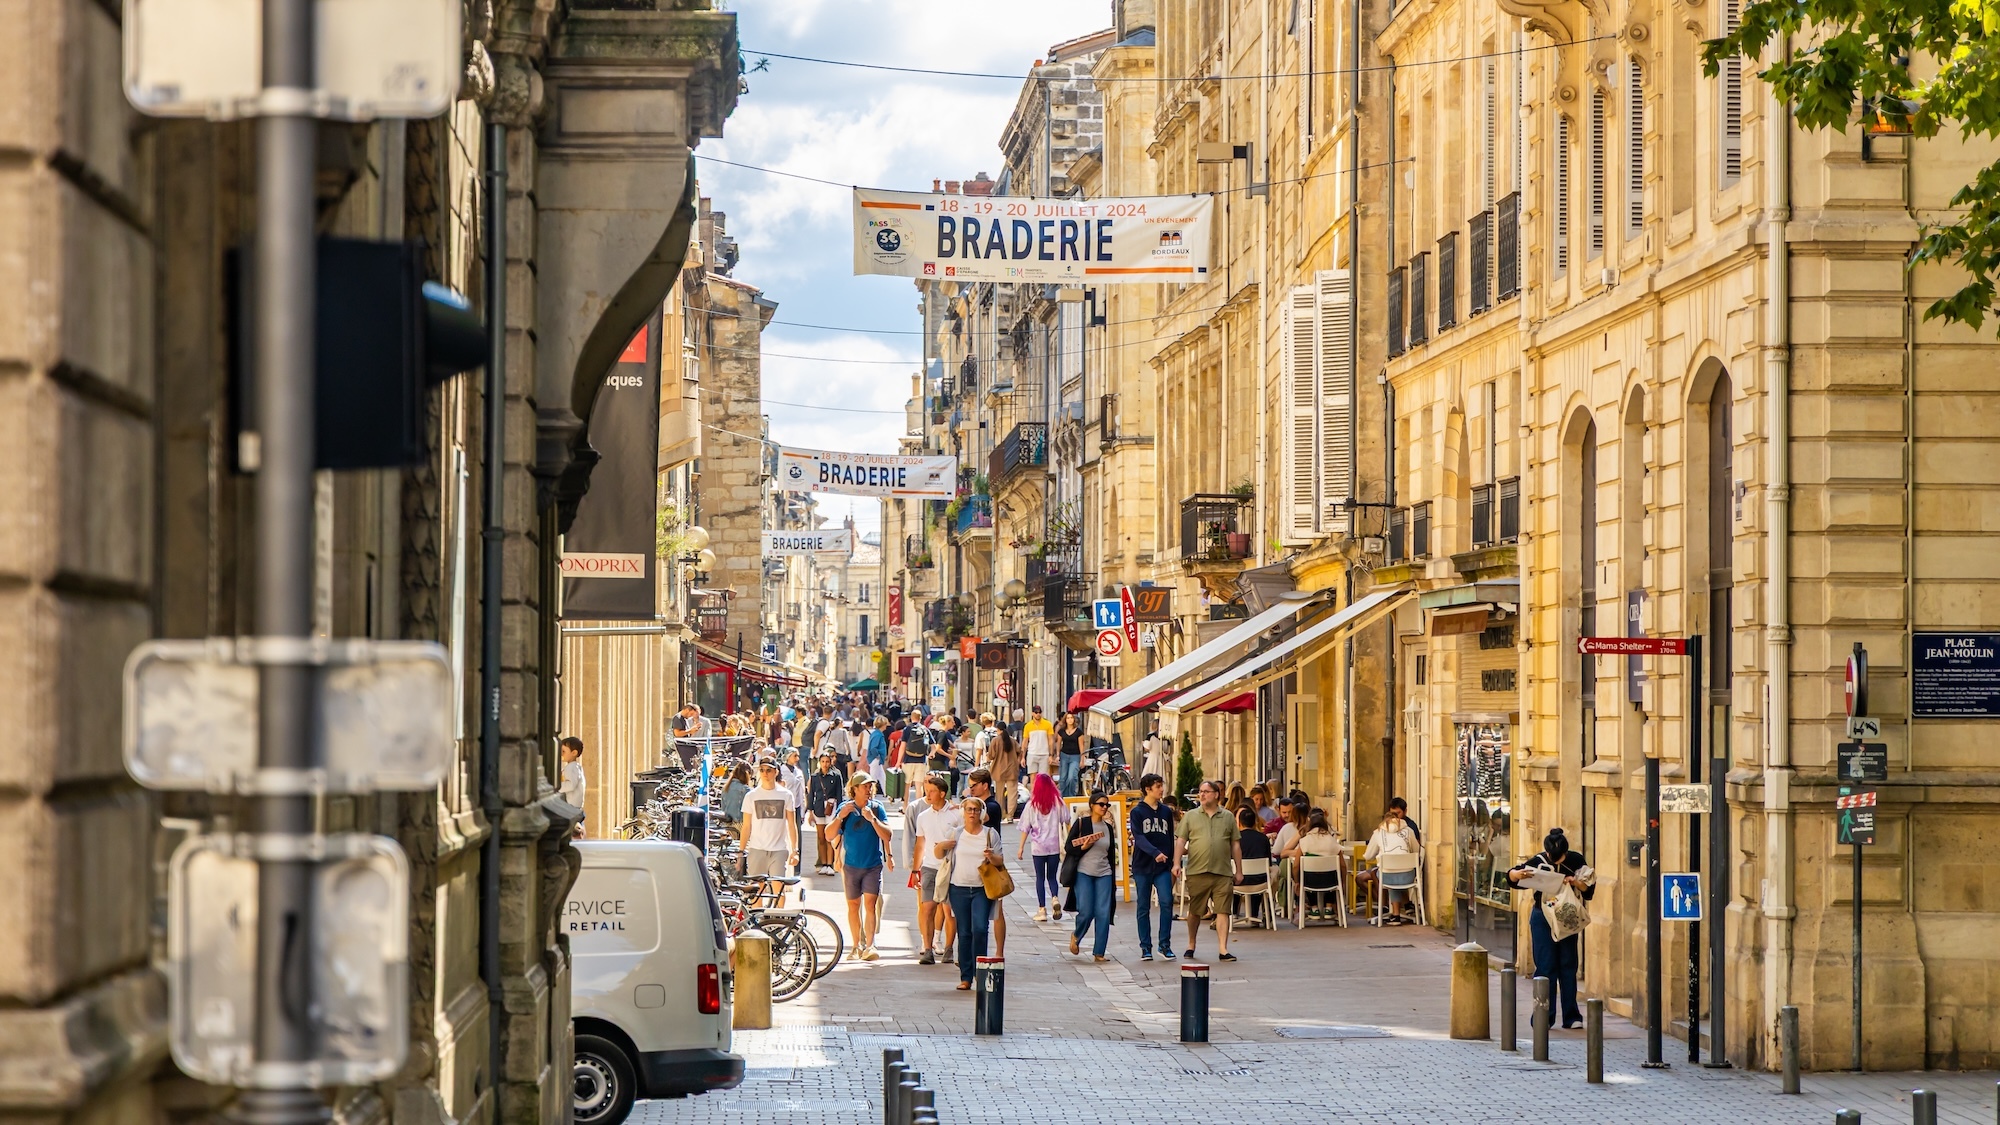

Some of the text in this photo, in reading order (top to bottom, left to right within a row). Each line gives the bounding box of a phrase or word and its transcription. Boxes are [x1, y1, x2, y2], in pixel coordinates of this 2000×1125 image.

[940, 199, 959, 213] 18
[973, 202, 993, 214] 19
[1006, 203, 1027, 216] 20
[1034, 204, 1098, 217] JUILLET
[1106, 203, 1147, 217] 2024
[879, 232, 899, 244] 3€
[937, 215, 1113, 262] BRADERIE
[1151, 248, 1190, 256] BORDEAUX
[1005, 267, 1024, 279] TBM
[821, 452, 831, 460] 18
[838, 454, 848, 462] 19
[854, 454, 865, 463] 20
[867, 455, 899, 464] JUILLET
[903, 457, 924, 465] 2024
[819, 462, 907, 488] BRADERIE
[772, 537, 823, 550] BRADERIE
[1124, 601, 1137, 639] TABAC
[1595, 642, 1645, 651] Mama Shelter
[1944, 638, 1976, 648] PLACE
[1924, 648, 1994, 660] JEAN-MOULIN
[1142, 818, 1169, 835] GAP
[570, 921, 625, 931] RETAIL
